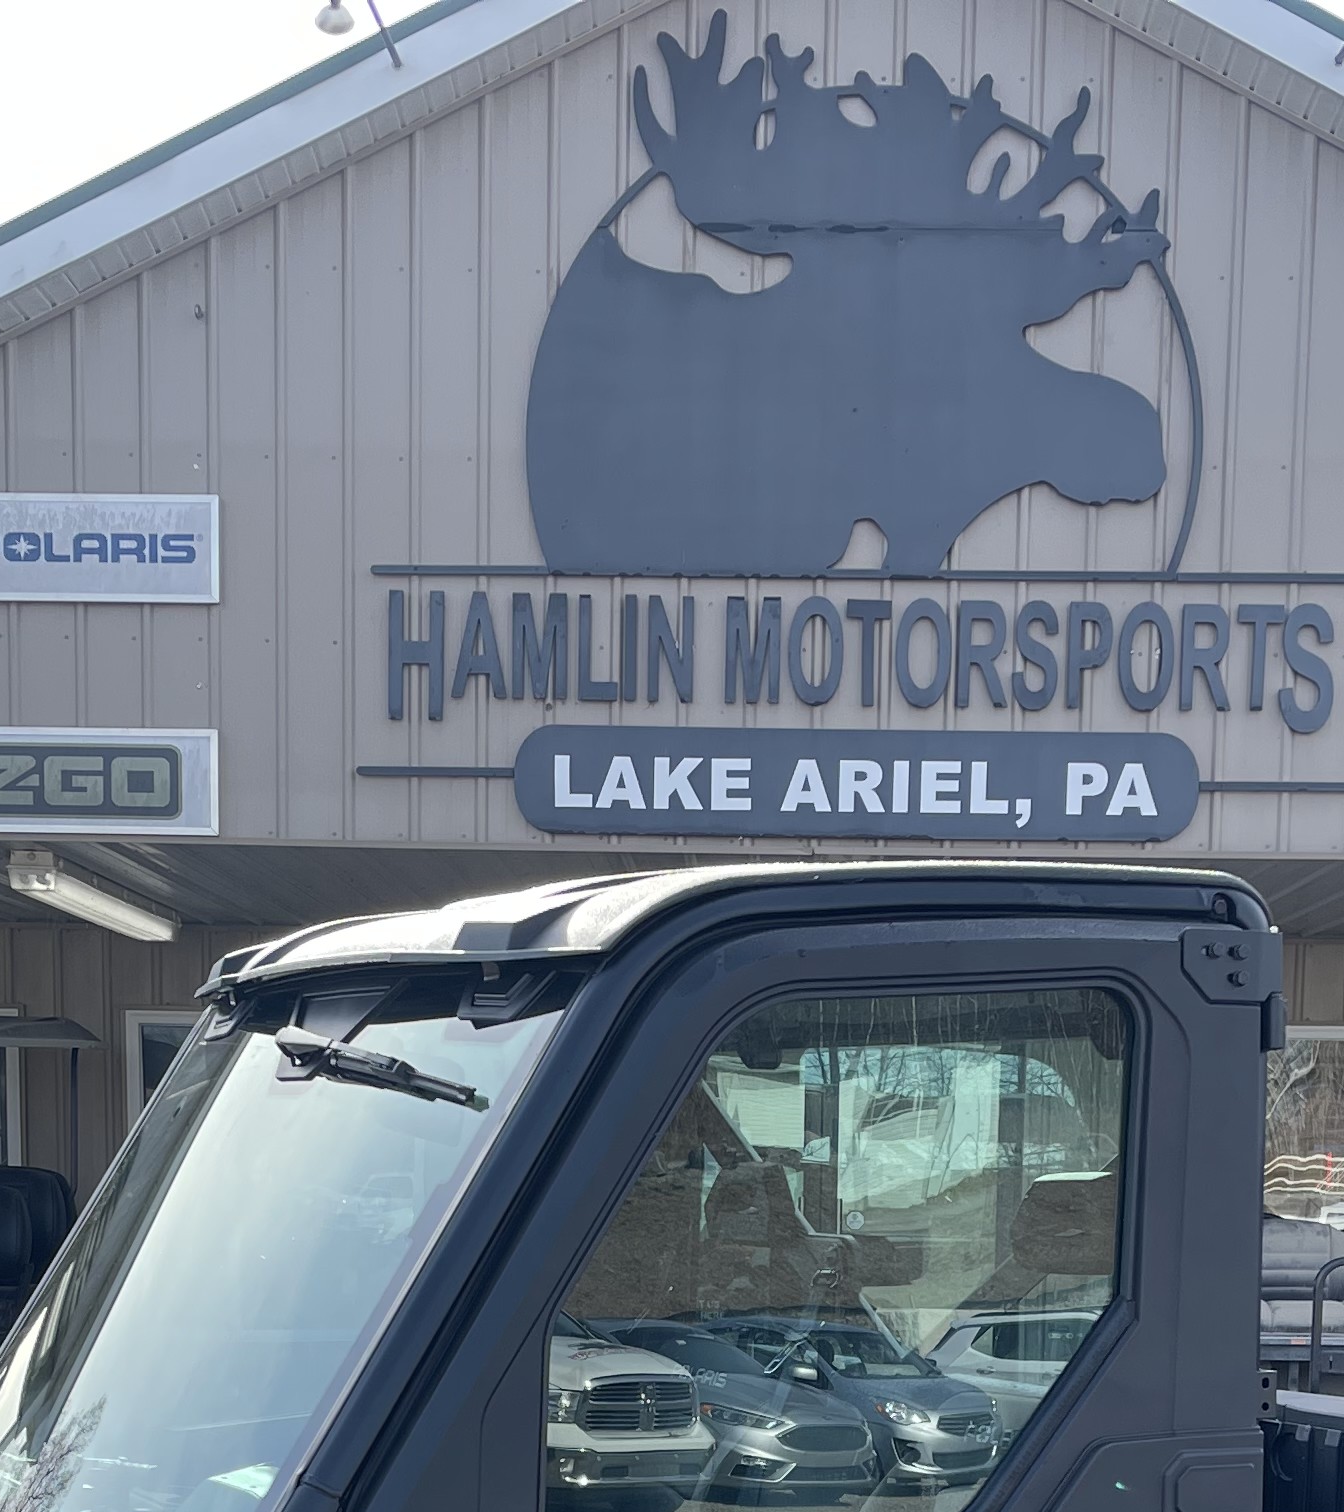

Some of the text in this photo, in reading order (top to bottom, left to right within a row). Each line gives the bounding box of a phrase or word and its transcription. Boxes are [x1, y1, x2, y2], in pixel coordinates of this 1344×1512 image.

[388, 589, 1335, 734] HAMLIN MOTORSPORTS
[554, 754, 1158, 828] LAKE ARIEL, PA
